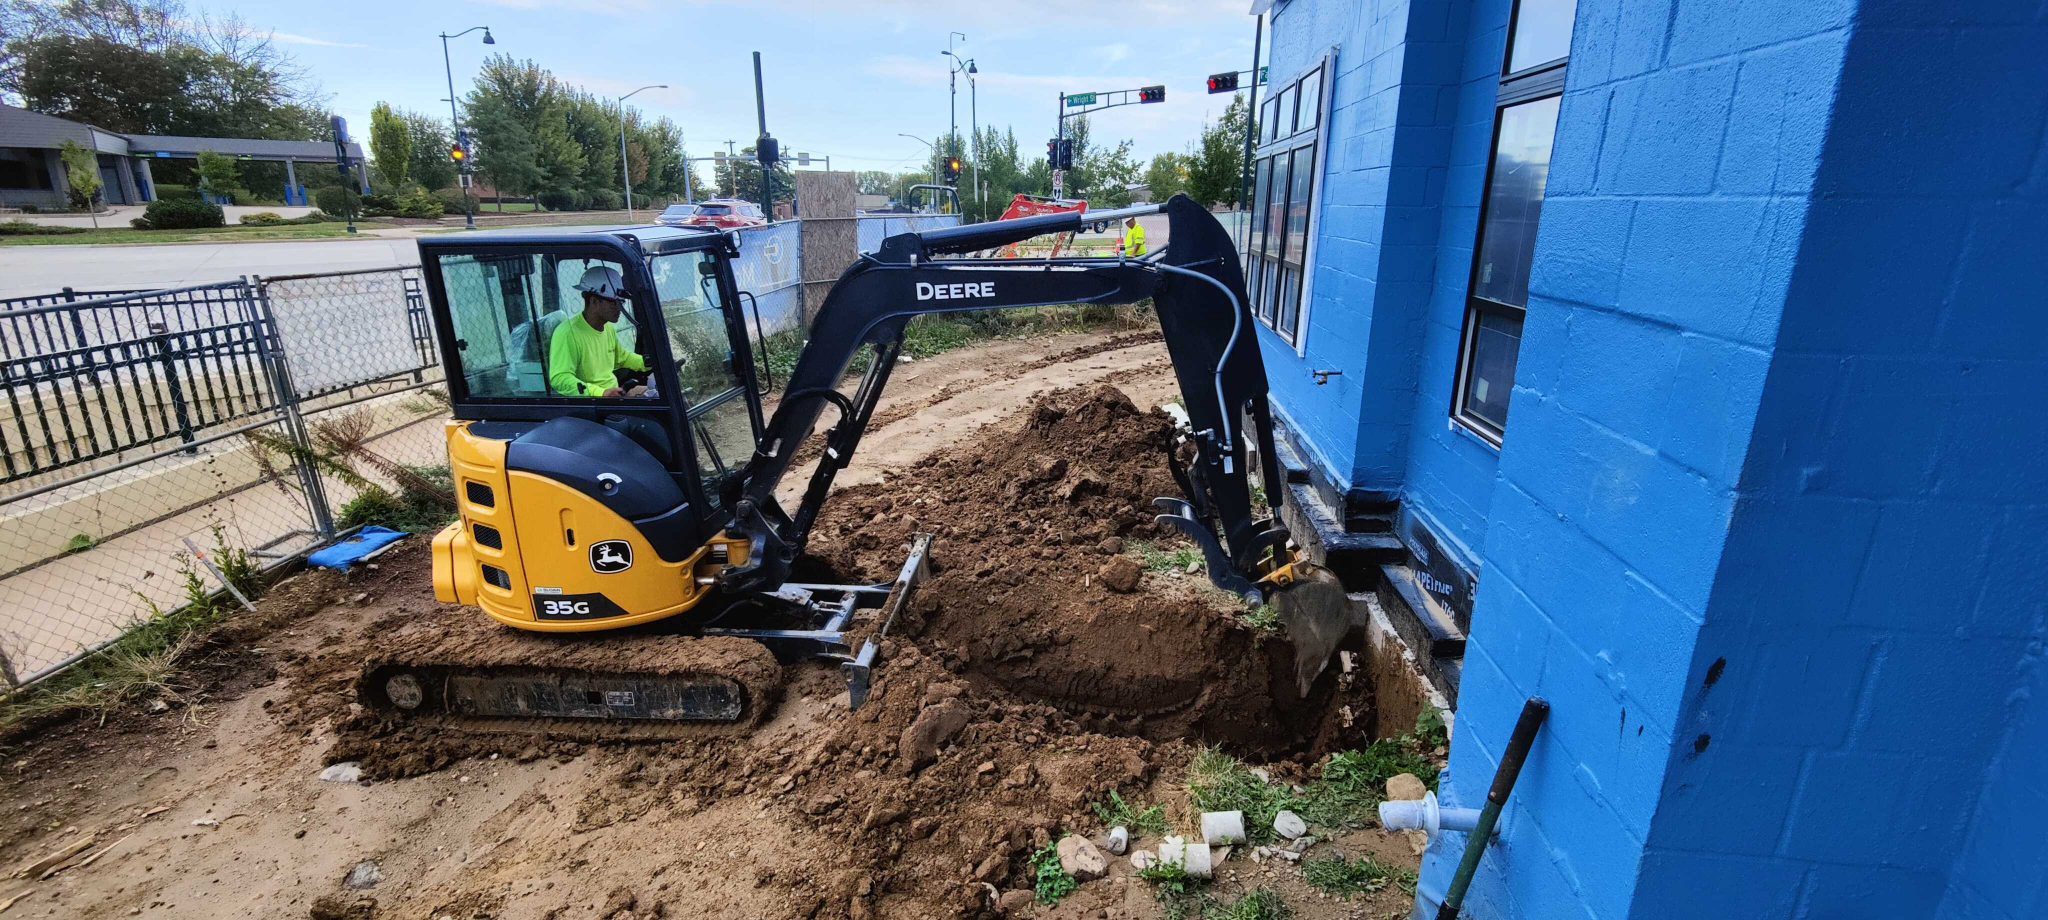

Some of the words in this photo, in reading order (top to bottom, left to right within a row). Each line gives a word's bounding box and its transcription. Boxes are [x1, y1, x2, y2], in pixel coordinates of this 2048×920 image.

[1073, 95, 1089, 104] Wright
[916, 282, 996, 300] DEERE
[543, 600, 590, 615] 35G
